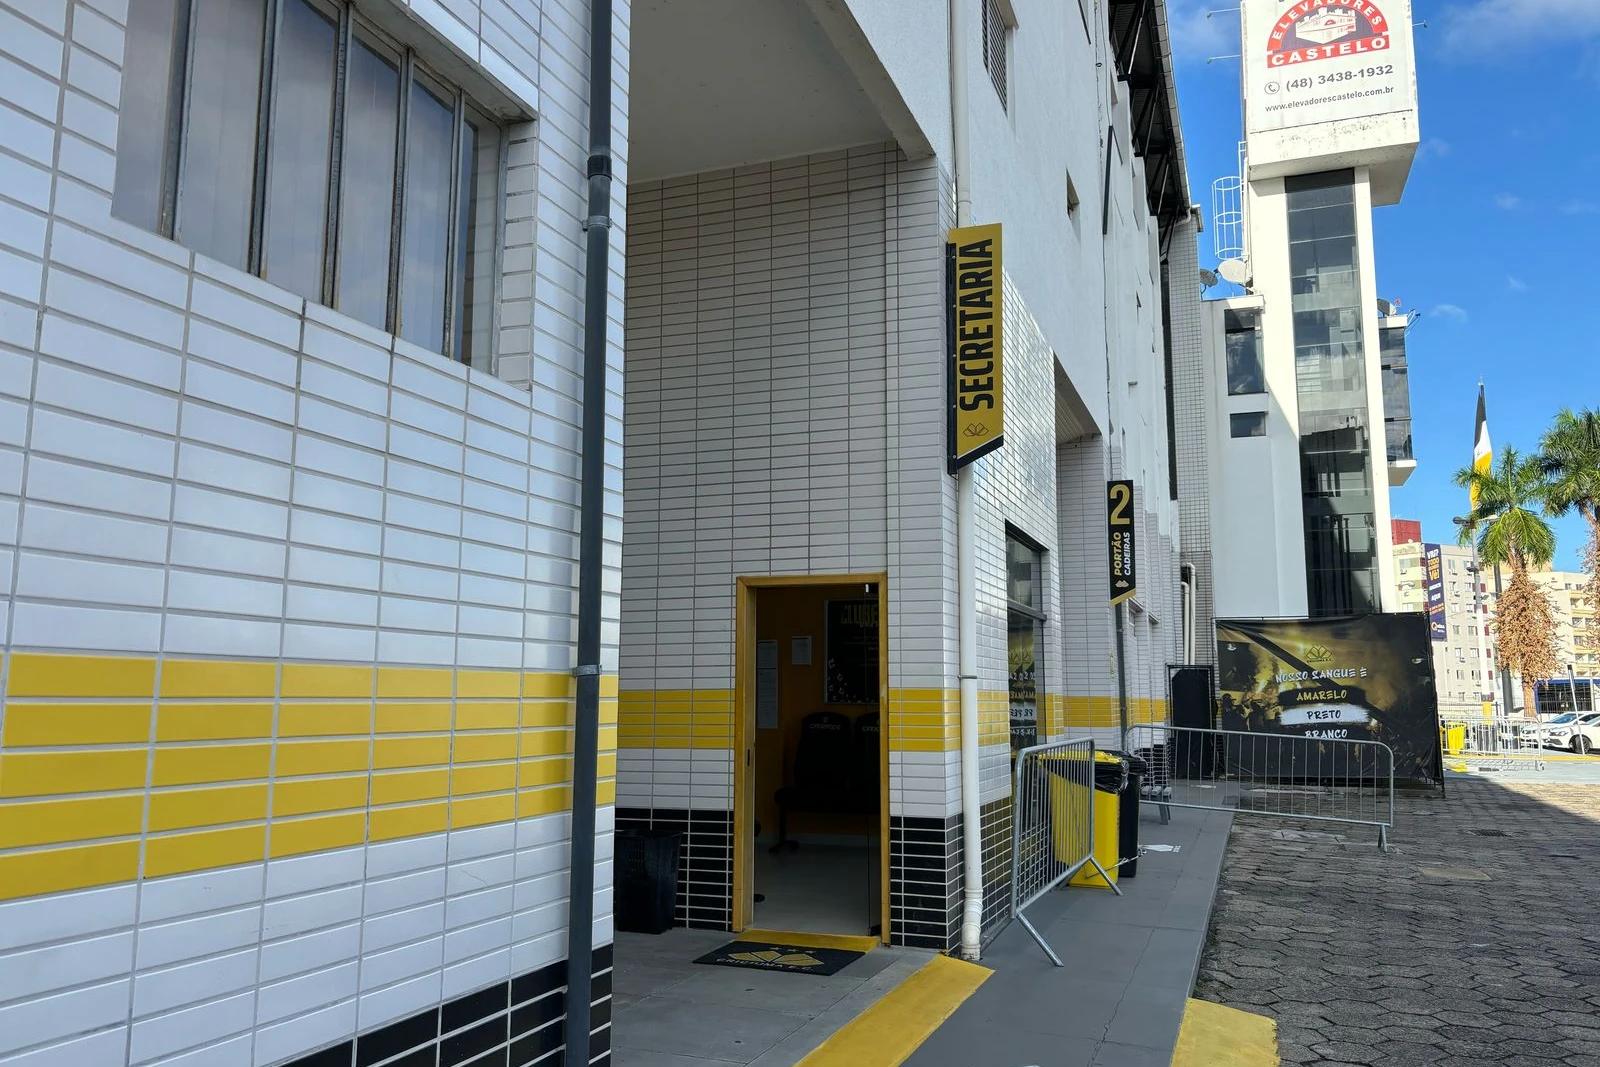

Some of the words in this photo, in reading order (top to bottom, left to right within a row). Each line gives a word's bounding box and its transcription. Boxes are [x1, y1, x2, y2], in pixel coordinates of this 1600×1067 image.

[1271, 37, 1386, 66] CASTELO
[1286, 77, 1313, 92] (48)
[1318, 64, 1393, 85] 3438-1932
[1265, 86, 1394, 113] www.elevadorescastelo.com.br
[958, 238, 994, 412] SECRETARIA
[1110, 483, 1131, 525] 2
[1111, 532, 1122, 576] PORTÃO
[1123, 532, 1131, 576] CADEIRAS
[1275, 671, 1308, 683] NOSSO
[1311, 668, 1356, 680] SANGUE
[1296, 689, 1347, 701] AMARELO
[1306, 709, 1342, 720] PRETO
